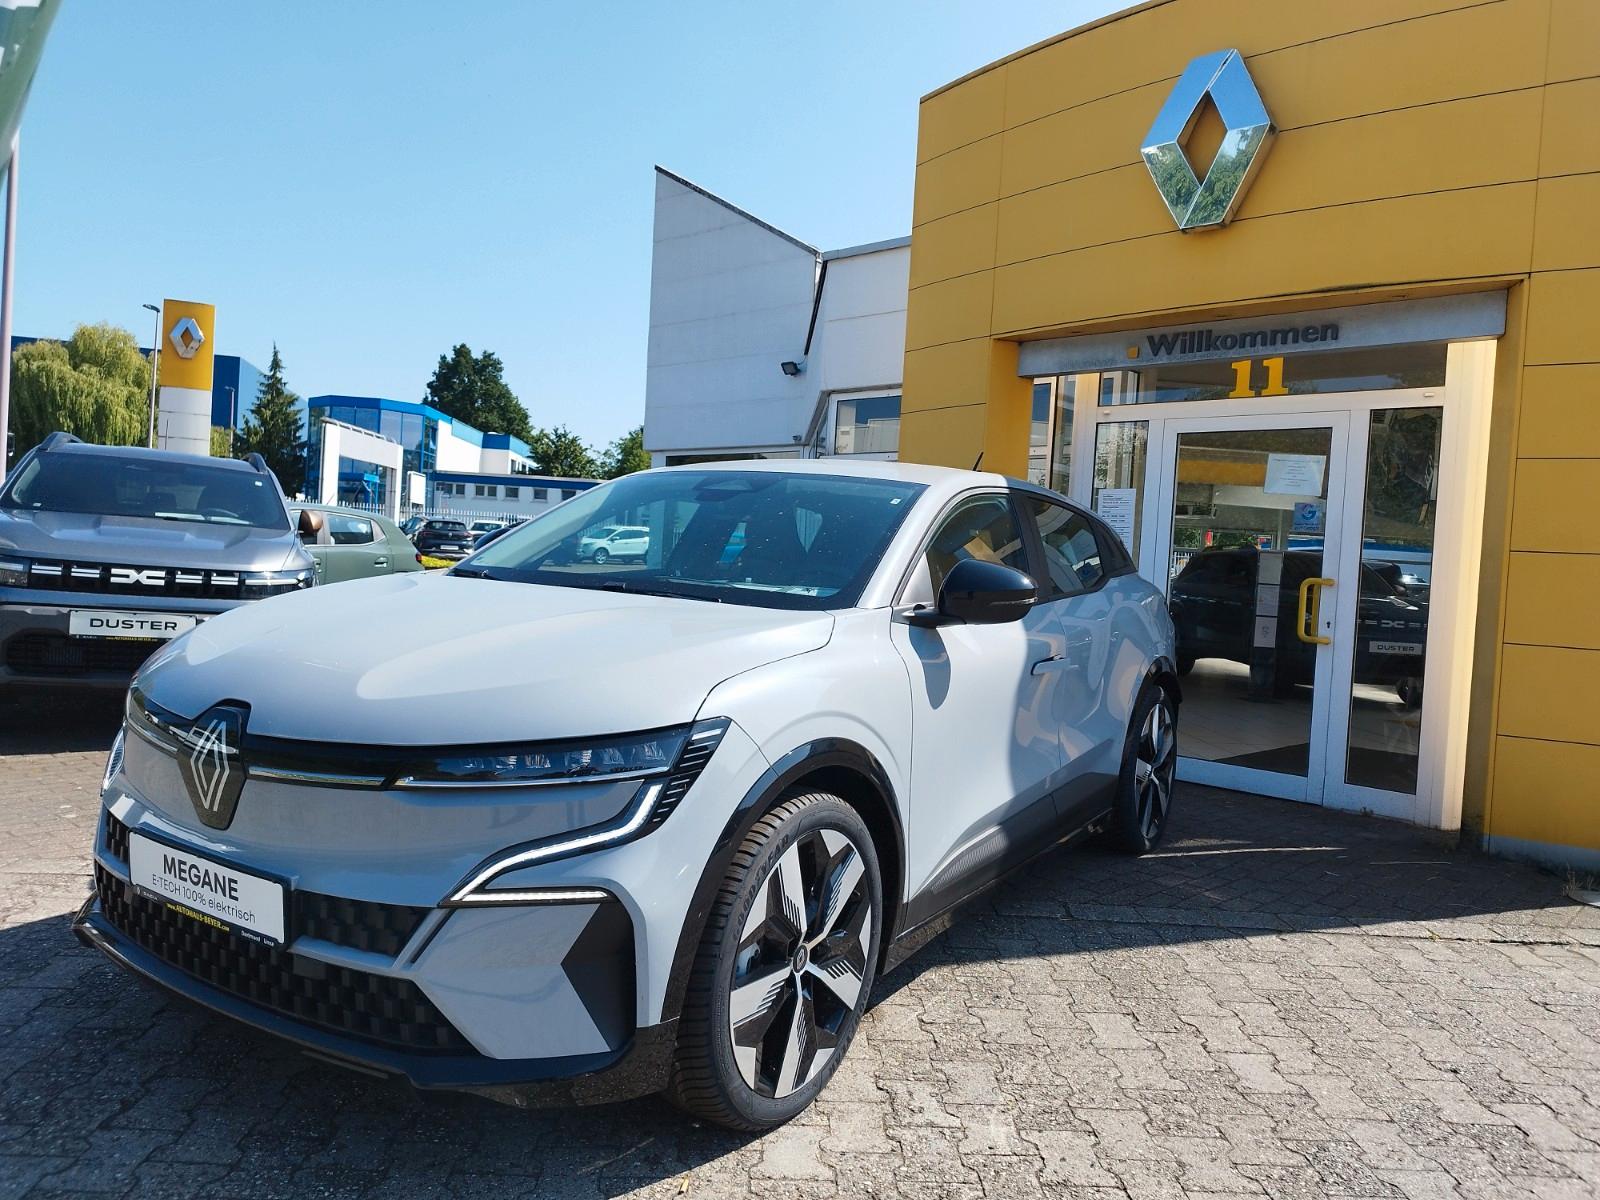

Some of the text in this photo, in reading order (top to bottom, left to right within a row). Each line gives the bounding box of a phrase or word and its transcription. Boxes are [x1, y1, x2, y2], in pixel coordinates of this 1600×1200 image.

[1146, 323, 1339, 357] Willkommen
[1229, 356, 1289, 399] 11
[89, 618, 178, 631] DUSTER
[1377, 644, 1415, 652] DUSTER
[163, 854, 239, 902] MEGANE
[152, 873, 181, 896] E-TECH
[182, 886, 207, 906] 100%
[208, 897, 256, 925] elektrisch
